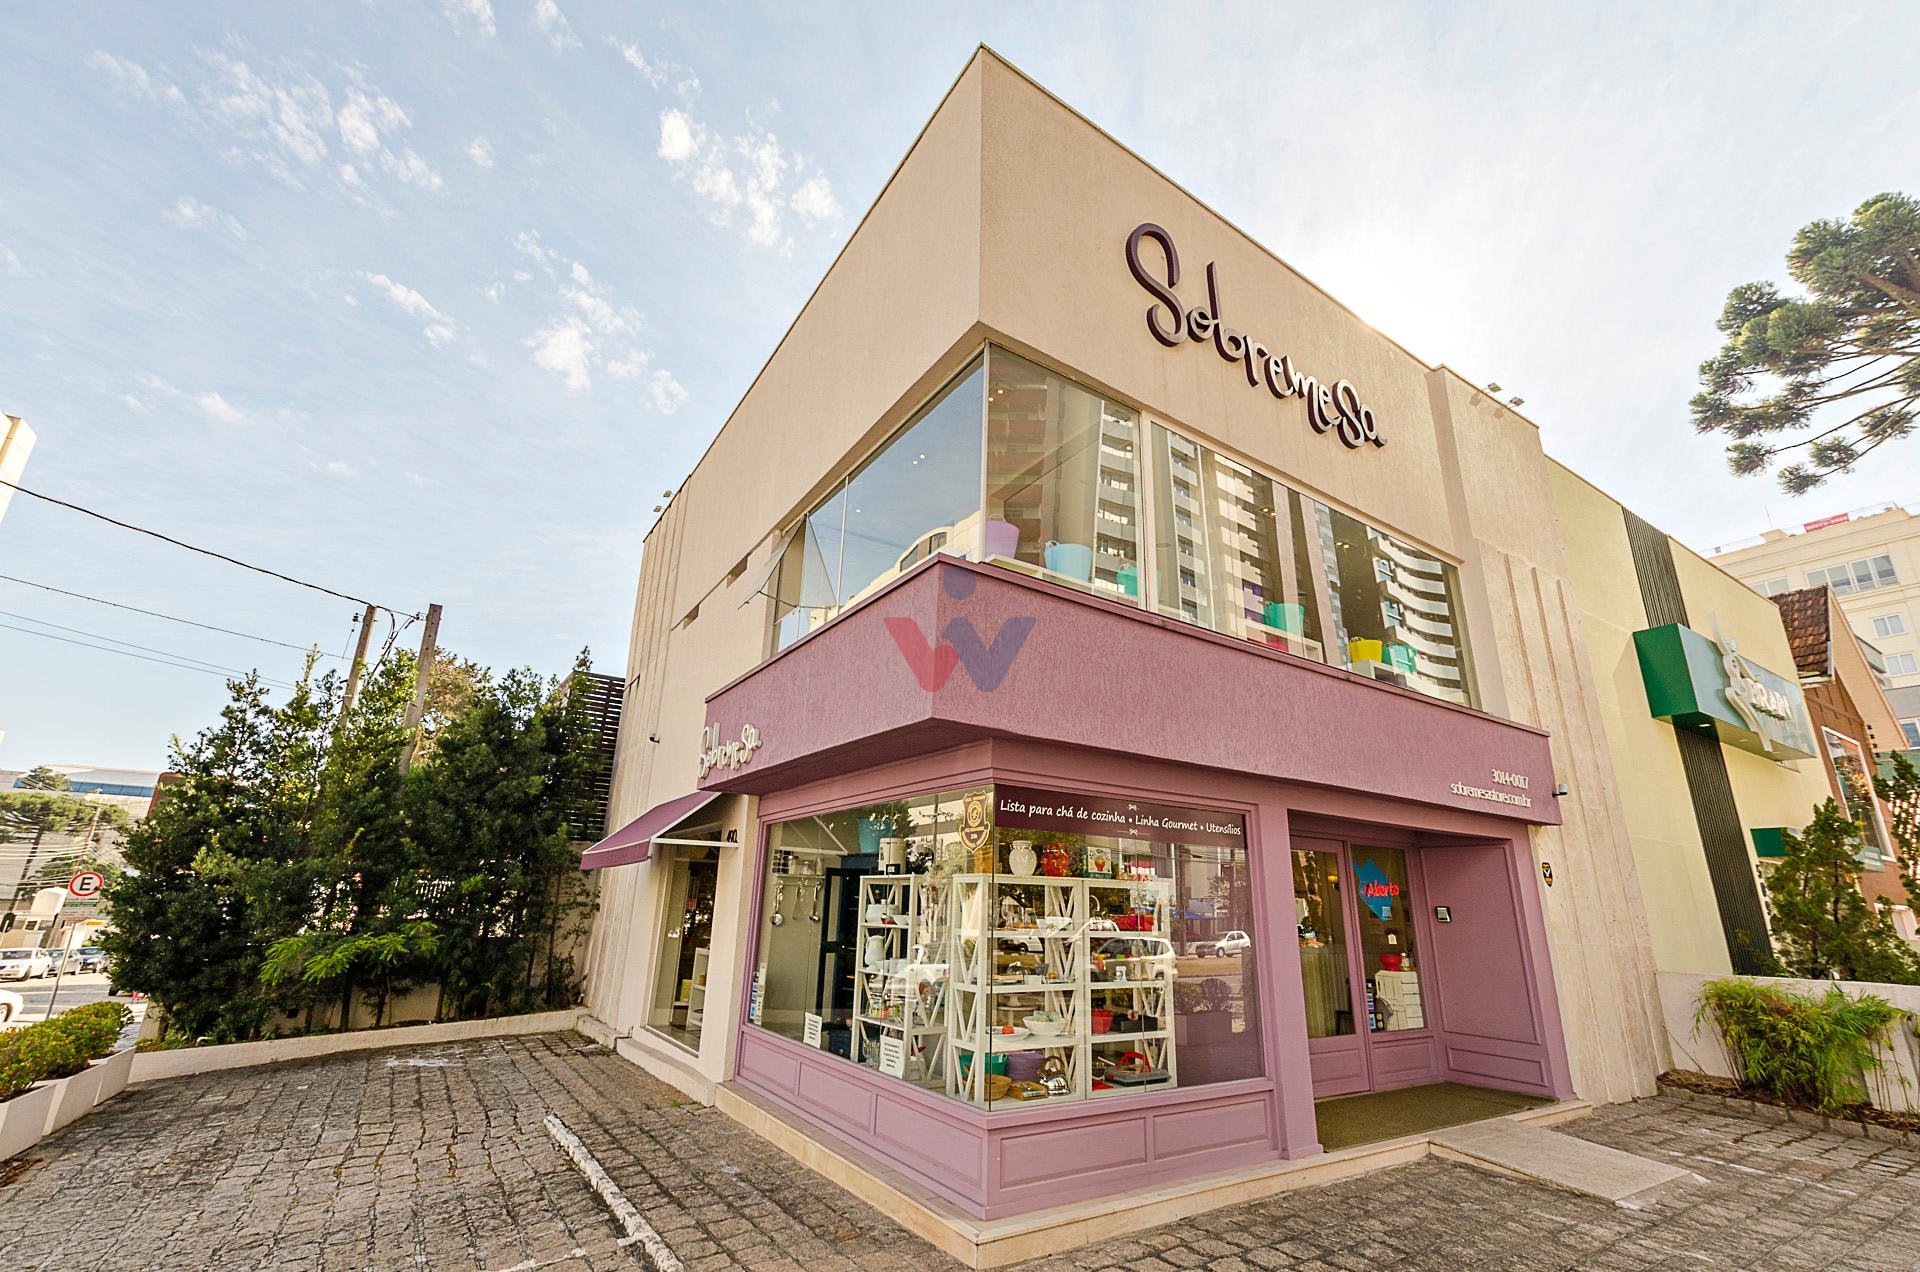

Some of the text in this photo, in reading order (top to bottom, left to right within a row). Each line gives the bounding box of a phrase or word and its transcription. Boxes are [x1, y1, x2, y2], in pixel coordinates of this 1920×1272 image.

[1000, 799, 1025, 812] Lista
[1028, 805, 1053, 818] para
[1056, 805, 1073, 818] chá
[1076, 807, 1088, 819] de
[1091, 810, 1125, 823] cozinha
[1135, 814, 1159, 827] Linha
[1162, 817, 1198, 831] Gourmet
[79, 876, 93, 891] E
